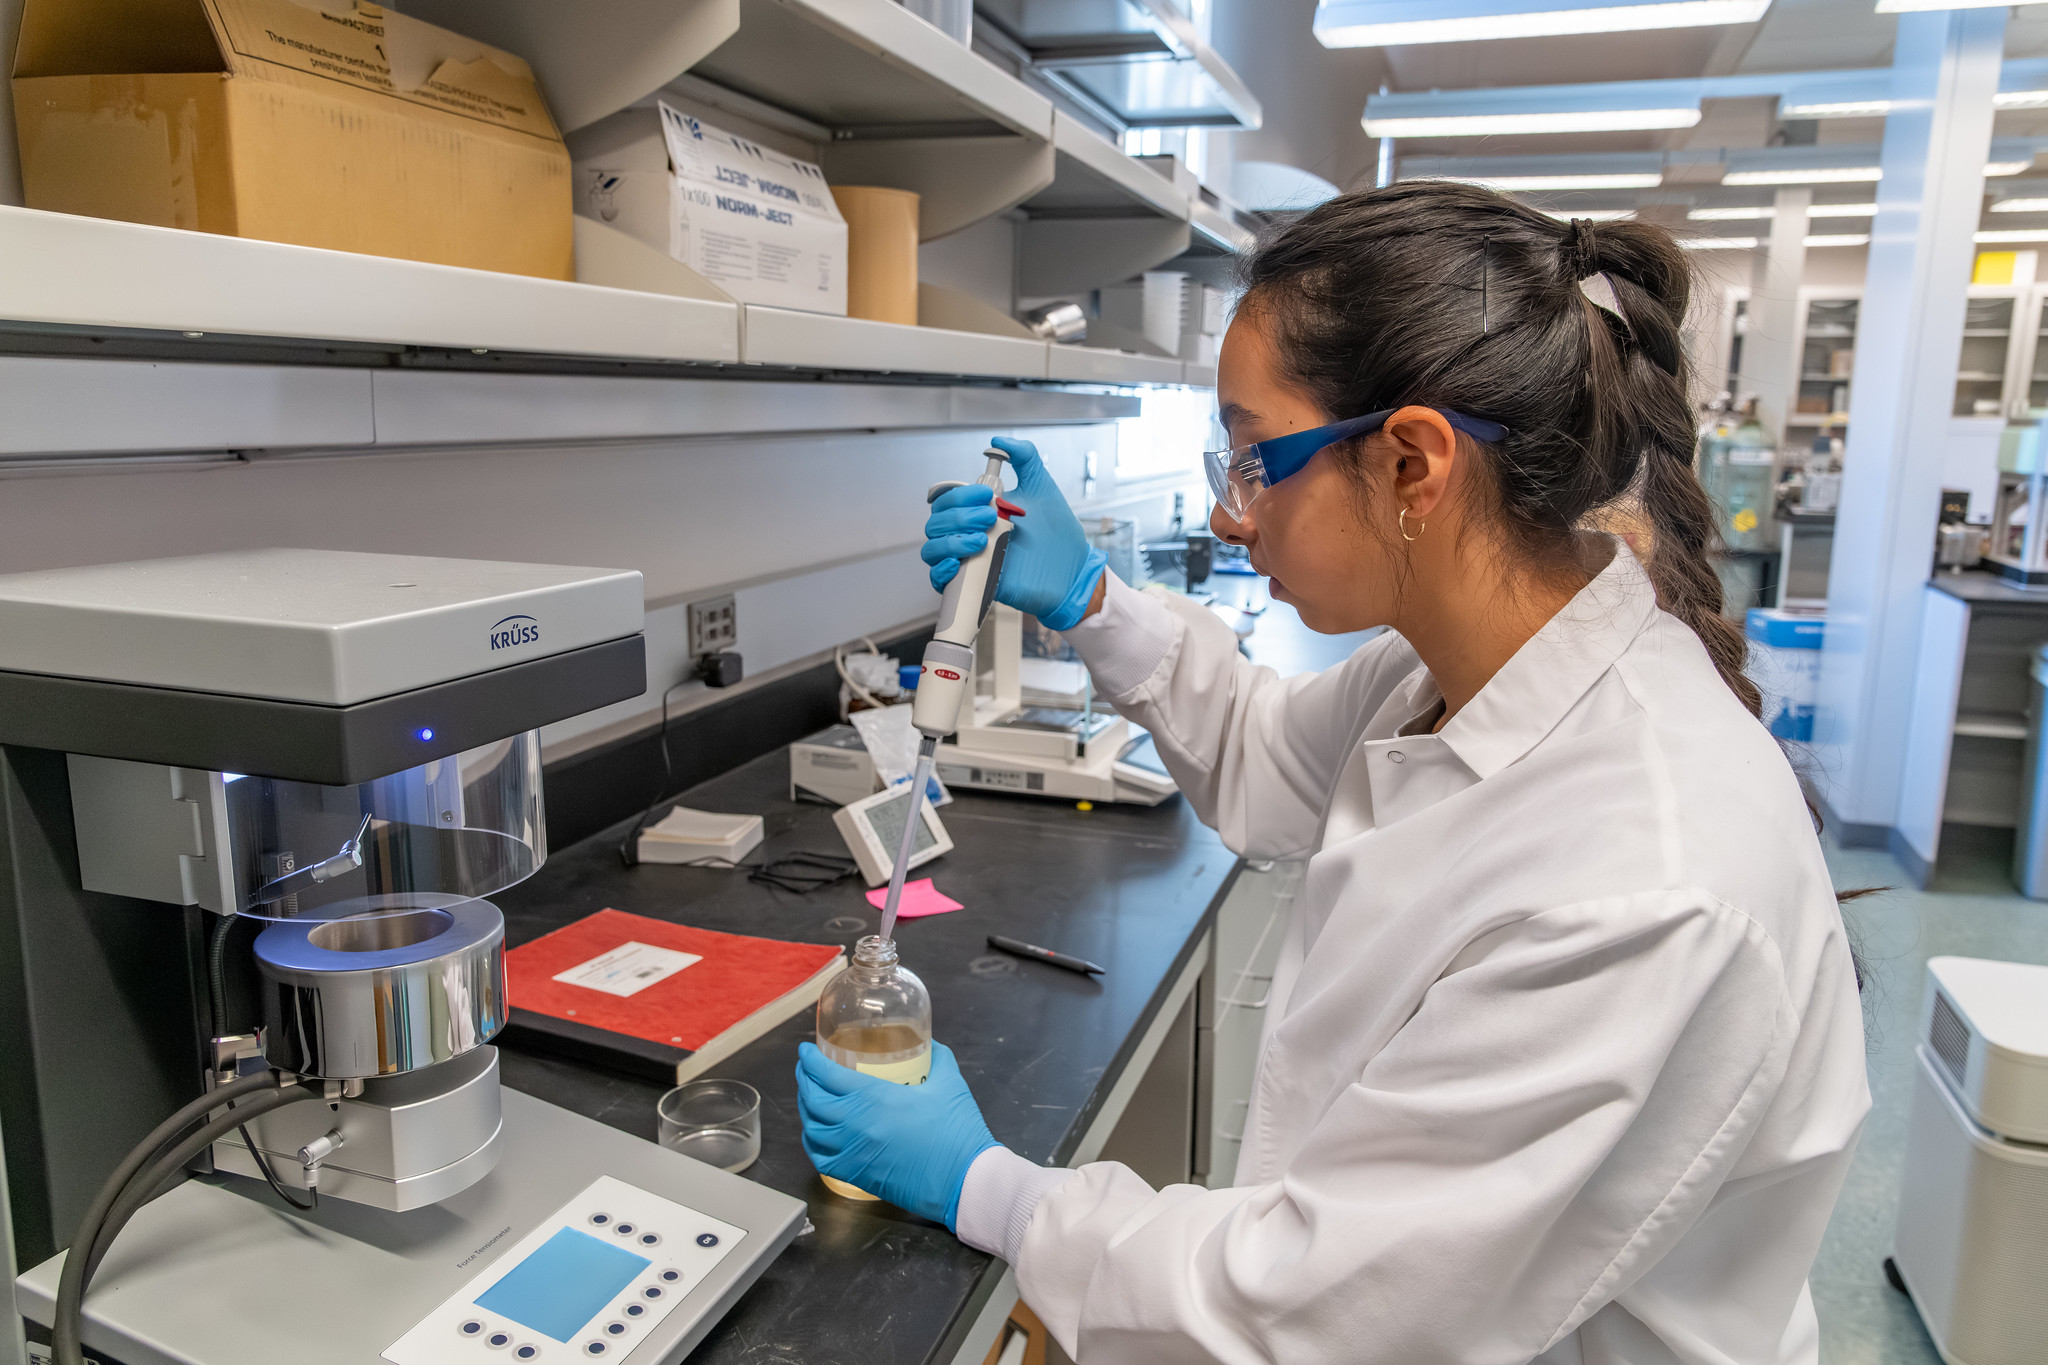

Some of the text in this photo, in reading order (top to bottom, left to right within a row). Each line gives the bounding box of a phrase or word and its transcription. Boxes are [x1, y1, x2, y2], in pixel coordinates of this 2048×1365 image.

[265, 29, 286, 46] The
[715, 195, 793, 227] NORM-JECT
[490, 624, 539, 651] KRÜSS
[456, 1226, 512, 1269] Force Tensiometer
